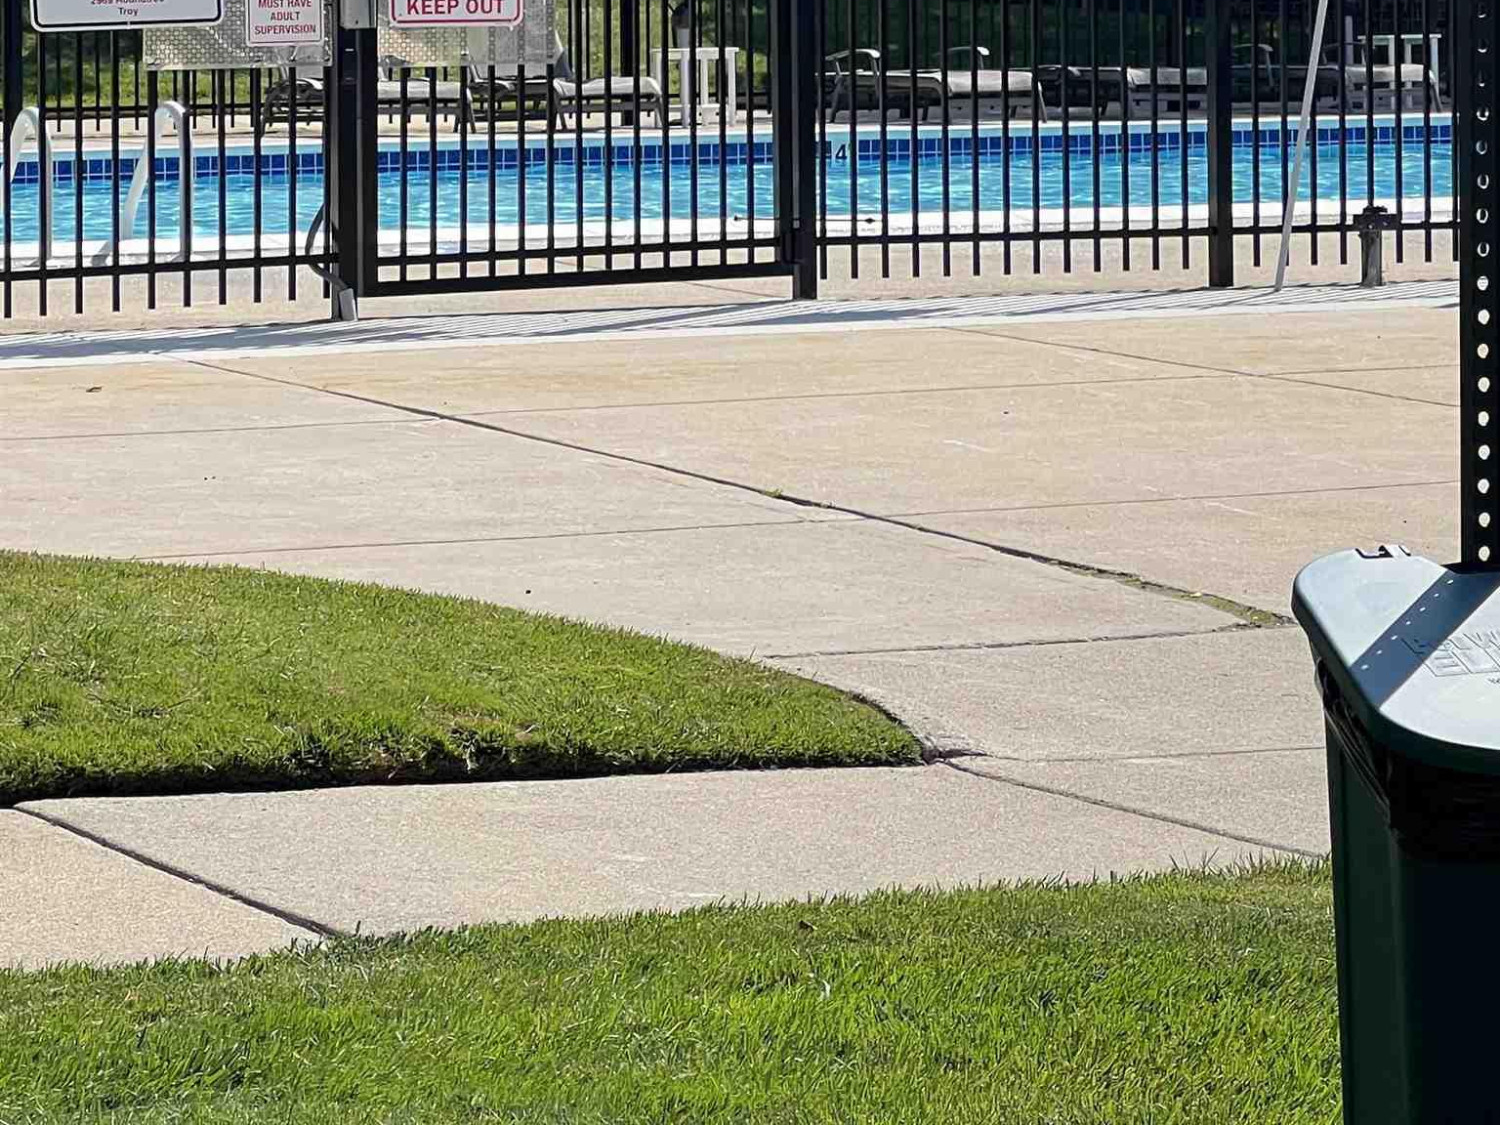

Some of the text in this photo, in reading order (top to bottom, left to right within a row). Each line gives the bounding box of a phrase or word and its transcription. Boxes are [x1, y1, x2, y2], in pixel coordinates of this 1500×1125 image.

[258, 0, 285, 9] MUST
[118, 7, 138, 16] Troy
[270, 11, 300, 21] ADULT
[254, 24, 316, 35] SUPERVISION
